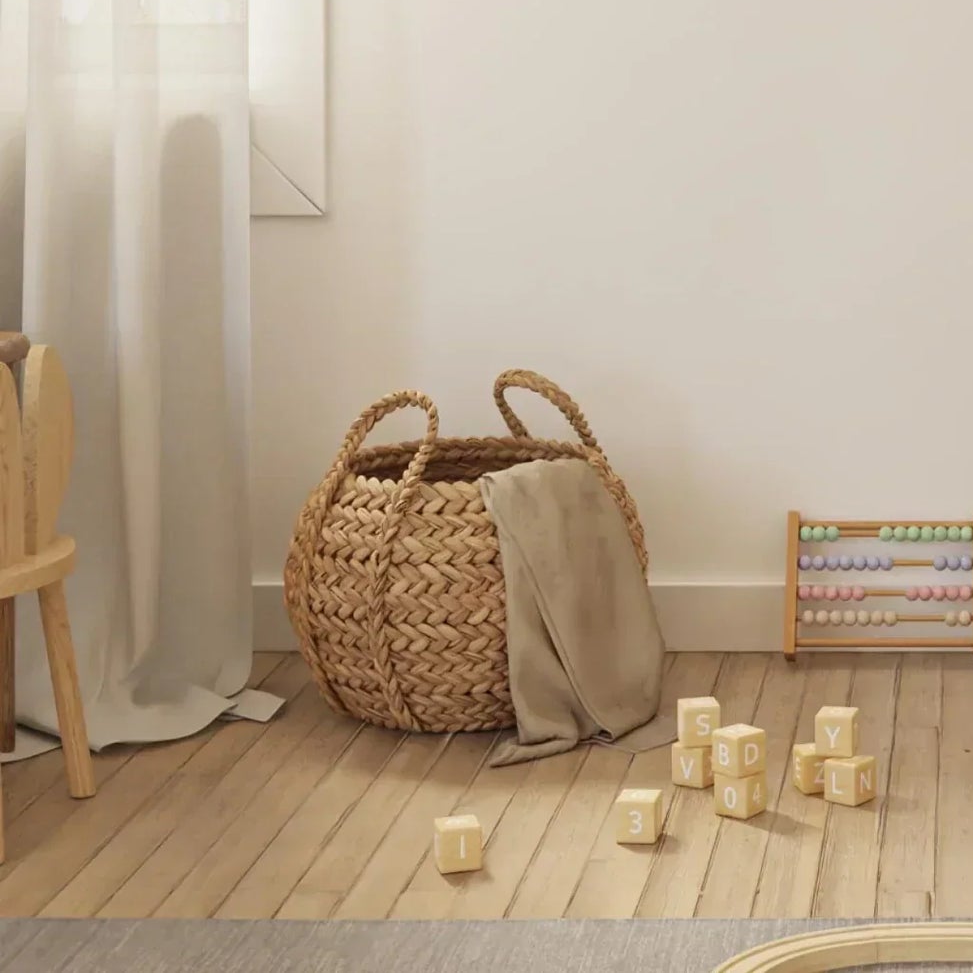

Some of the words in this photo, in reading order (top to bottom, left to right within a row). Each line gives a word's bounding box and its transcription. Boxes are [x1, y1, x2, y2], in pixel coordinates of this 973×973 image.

[696, 714, 711, 736] S
[824, 725, 841, 749] Y
[718, 742, 730, 766] B
[744, 742, 759, 765] D
[679, 755, 694, 780] V
[831, 770, 844, 795] L
[860, 768, 872, 795] N
[628, 810, 643, 835] 3
